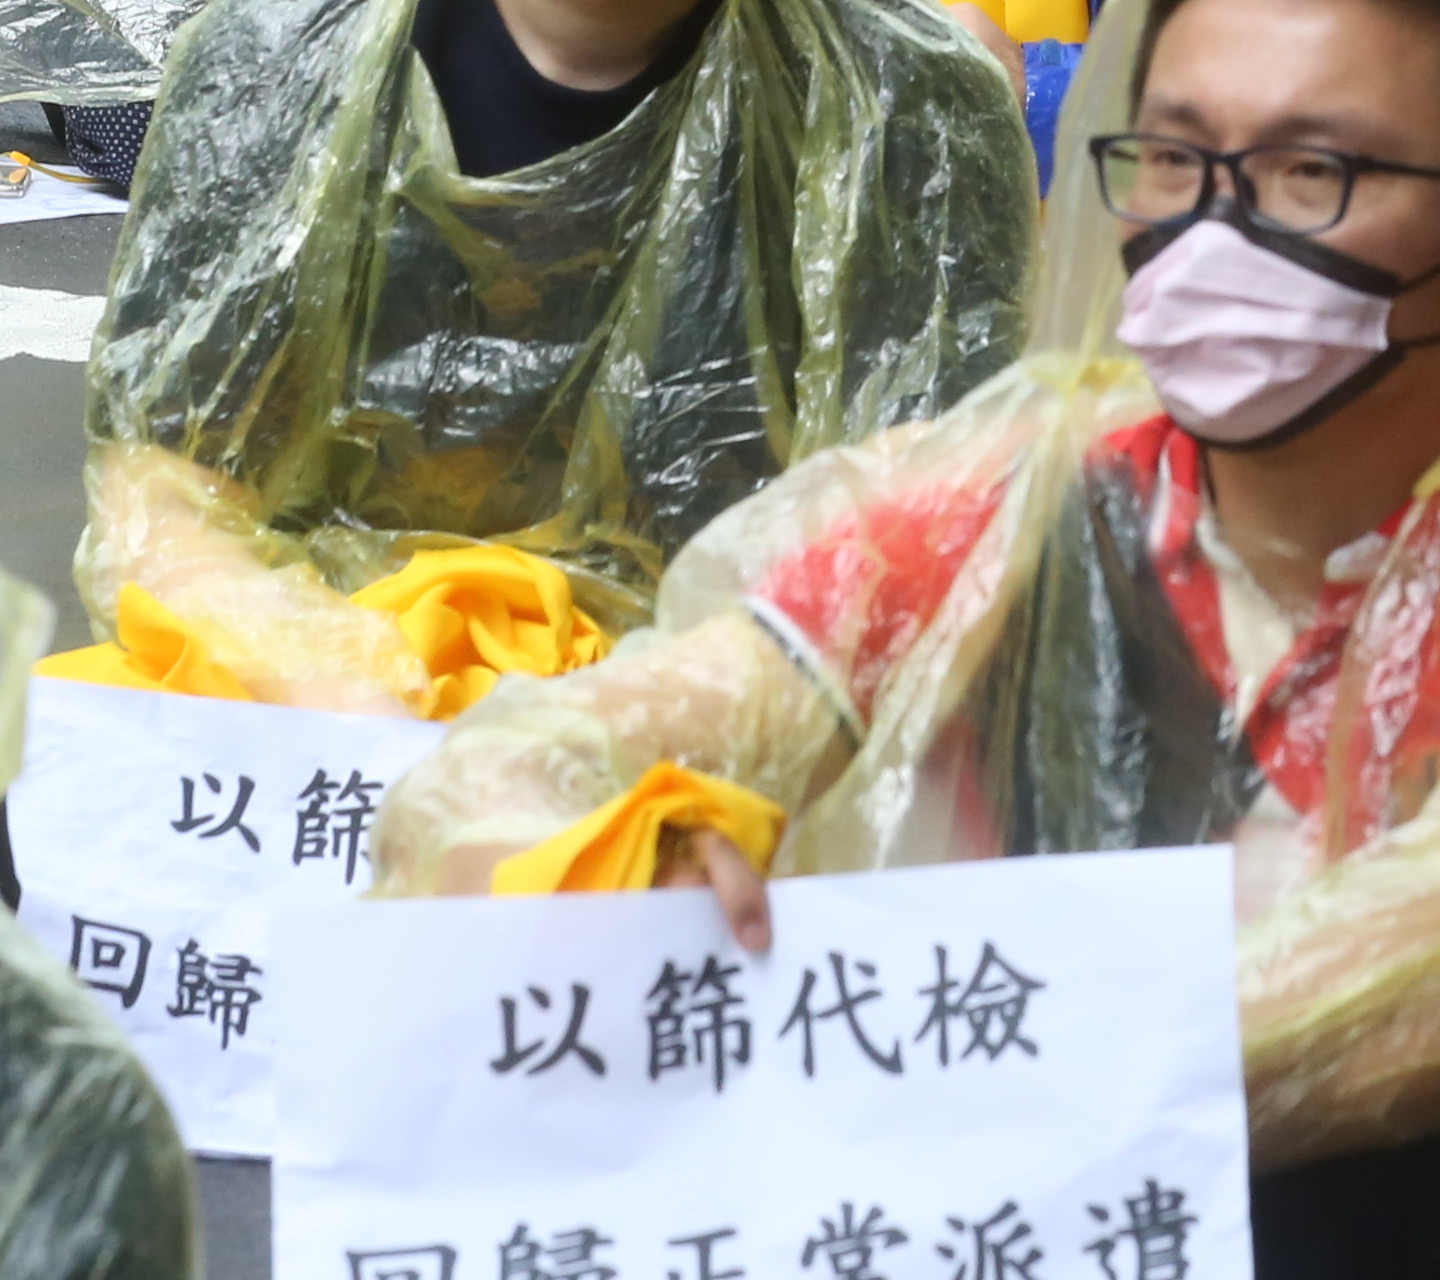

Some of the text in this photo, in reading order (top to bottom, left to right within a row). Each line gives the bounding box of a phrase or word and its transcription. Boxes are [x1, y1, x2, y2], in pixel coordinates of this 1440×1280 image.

[70, 914, 263, 1050] 回歸
[490, 942, 1047, 1094] 以篩代檢
